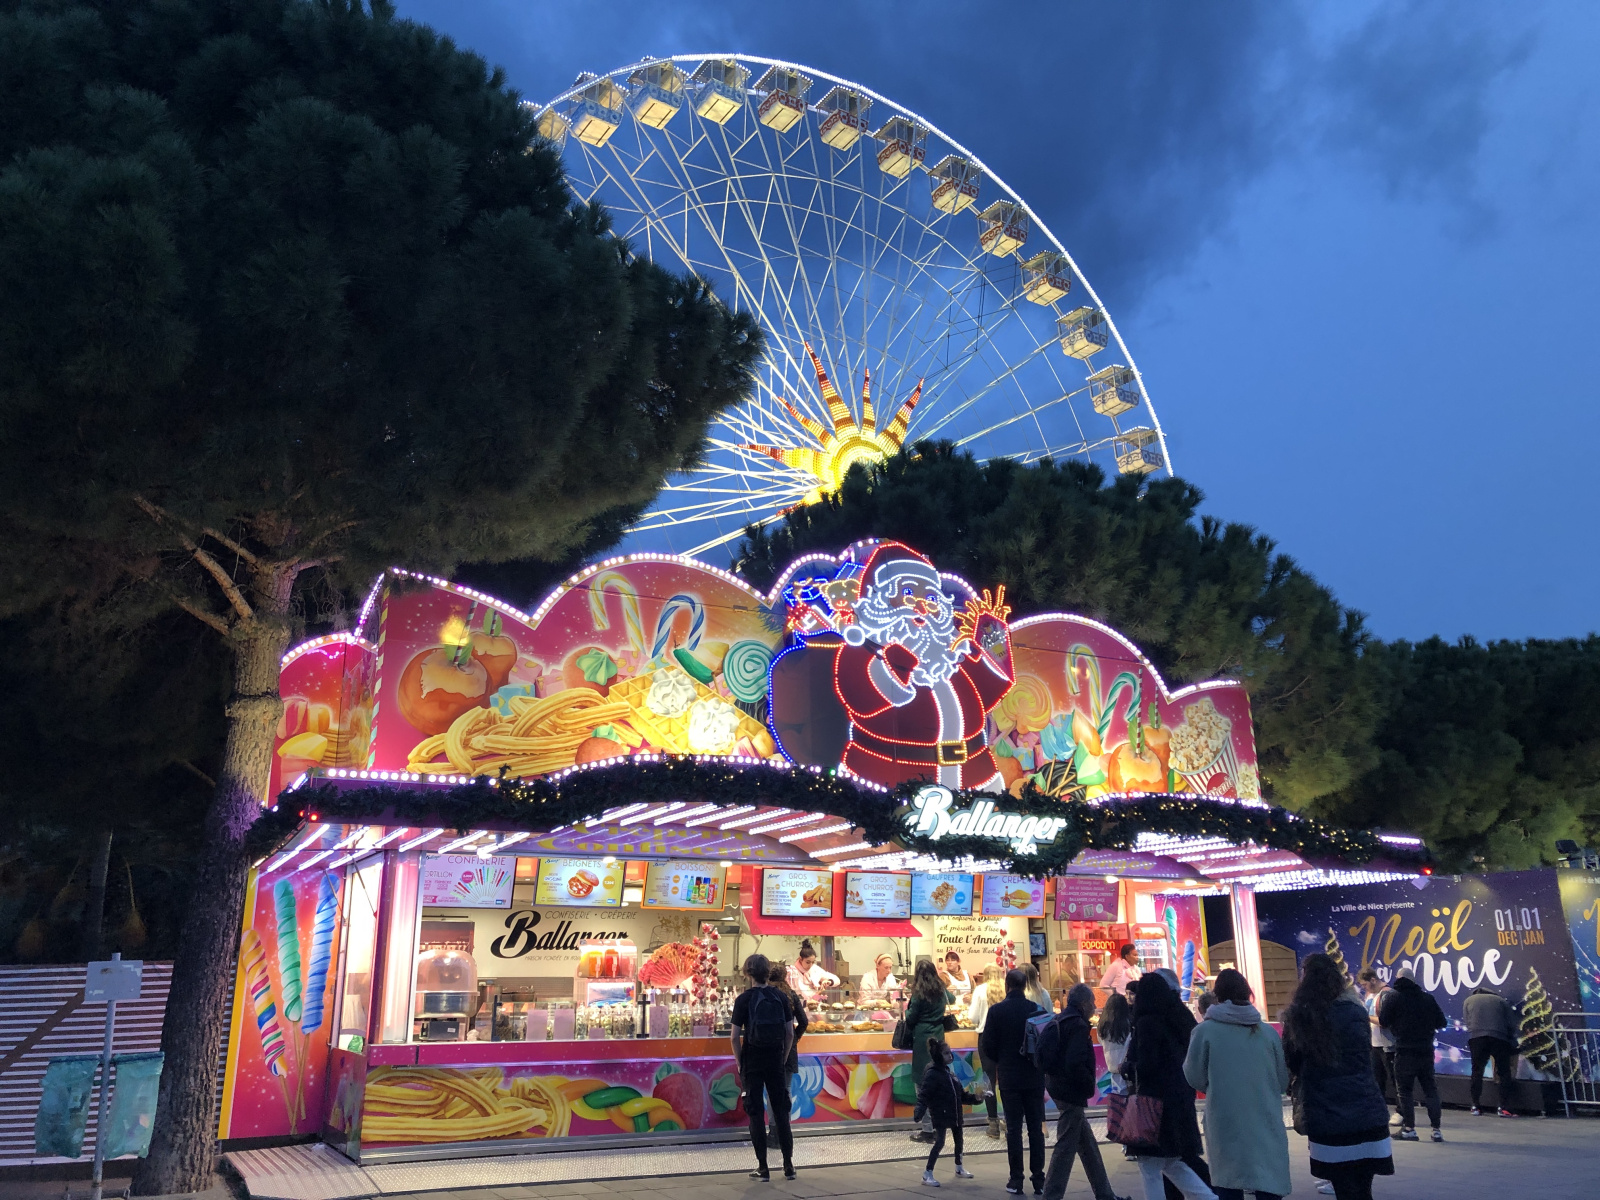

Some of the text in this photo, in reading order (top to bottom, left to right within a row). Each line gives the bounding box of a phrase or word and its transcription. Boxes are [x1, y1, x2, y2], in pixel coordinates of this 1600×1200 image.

[905, 785, 1068, 855] Ballanger
[447, 855, 506, 866] CONFISERIE
[562, 859, 602, 868] BEIGNETS
[674, 862, 716, 872] BOISSONS
[788, 872, 808, 880] GROS
[870, 875, 888, 883] GROS
[781, 880, 814, 888] CHURROS
[863, 883, 894, 891] CHURROS
[1340, 904, 1357, 912] Ville
[1357, 903, 1367, 911] de
[1367, 902, 1384, 910] Nice
[1384, 901, 1415, 911] présente
[544, 909, 638, 921] CONFISERIE CRÊPERIE
[1494, 907, 1541, 931] 01 01
[936, 933, 1002, 945] Toute l'Année
[1349, 899, 1474, 969] Noël
[1497, 930, 1545, 946] DEC JAN
[1376, 959, 1392, 983] à
